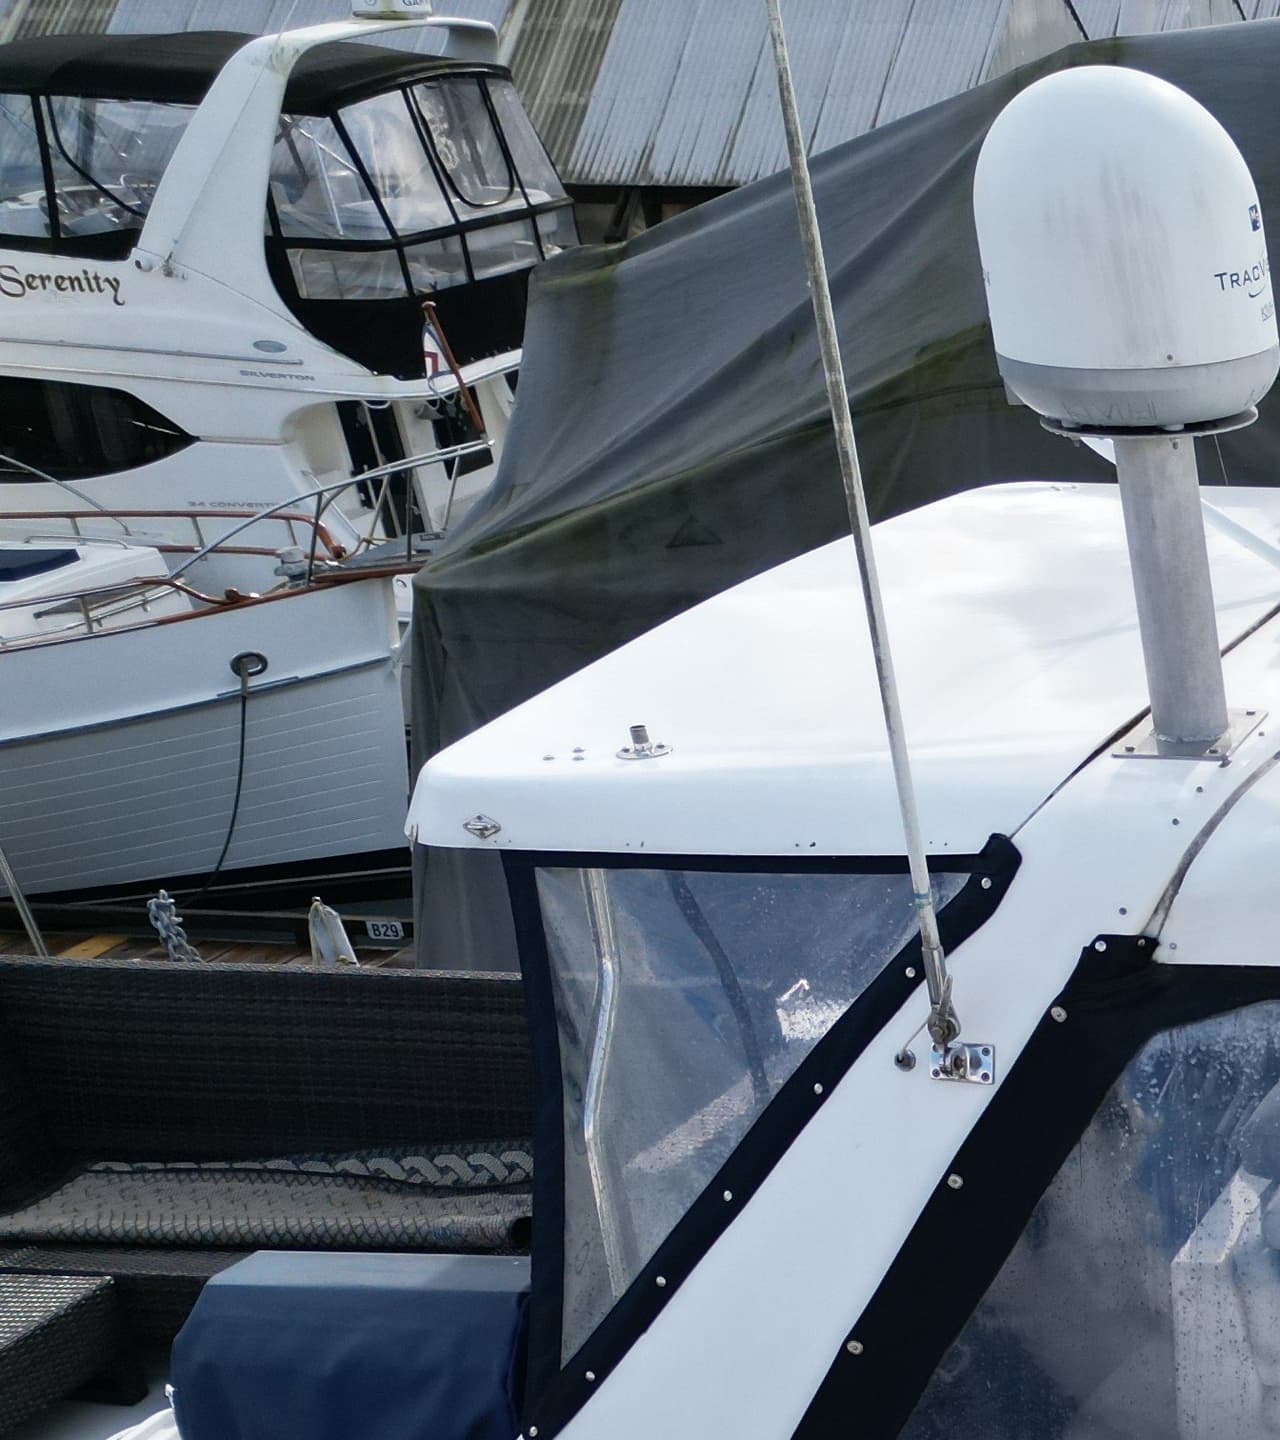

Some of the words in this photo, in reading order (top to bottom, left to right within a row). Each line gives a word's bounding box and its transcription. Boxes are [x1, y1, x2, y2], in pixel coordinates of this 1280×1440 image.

[0, 265, 126, 306] Serenity
[239, 369, 316, 382] SILVERTON
[208, 501, 301, 510] CONVERTLE
[371, 923, 400, 938] B29
